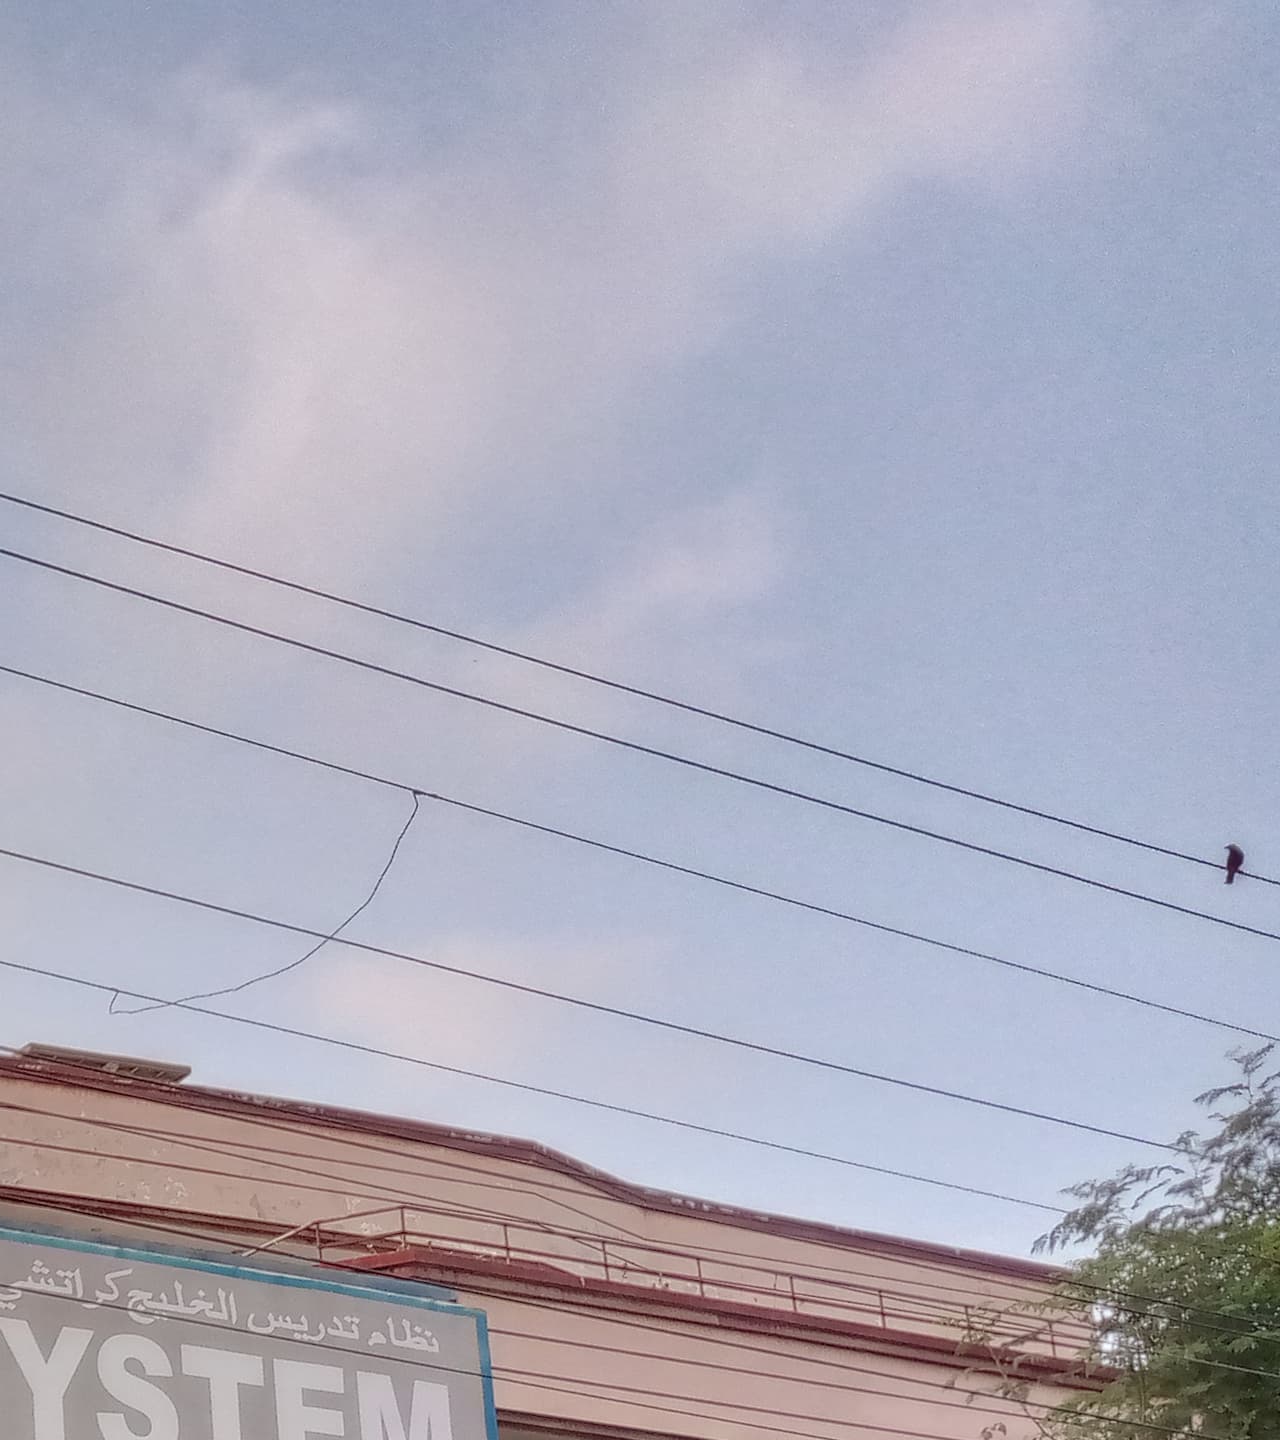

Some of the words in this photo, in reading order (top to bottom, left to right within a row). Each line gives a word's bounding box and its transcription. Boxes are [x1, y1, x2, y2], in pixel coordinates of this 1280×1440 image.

[126, 1279, 238, 1326] الخليج
[246, 1311, 361, 1342] تدريس
[367, 1315, 440, 1353] نظام
